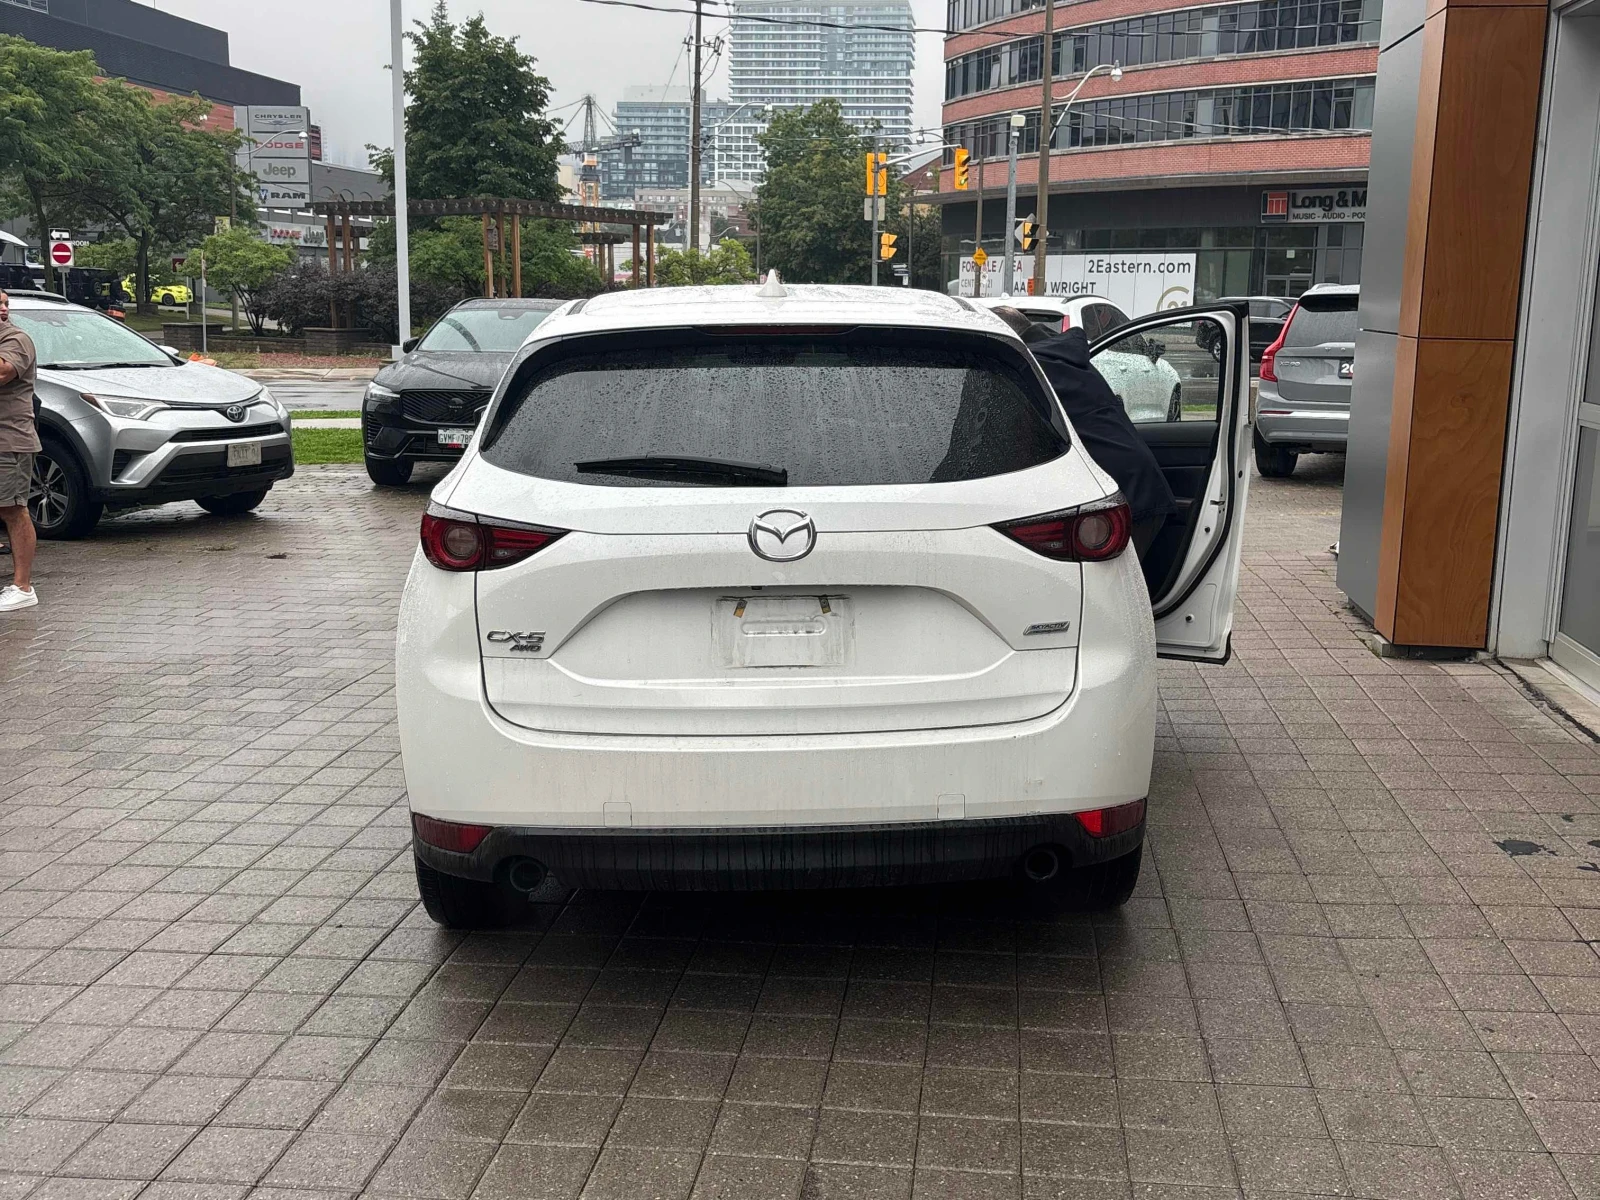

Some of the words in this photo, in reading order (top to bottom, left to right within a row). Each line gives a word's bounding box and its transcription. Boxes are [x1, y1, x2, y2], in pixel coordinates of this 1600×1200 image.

[255, 141, 304, 149] DODGE
[262, 162, 297, 178] Jeep
[1291, 192, 1334, 212] Long
[1335, 190, 1349, 208] &
[1322, 212, 1346, 220] AUDIO
[1088, 259, 1191, 274] 2Eastern.com
[1050, 281, 1097, 294] WRIGHT
[487, 630, 546, 643] CX-5
[509, 644, 542, 652] AWD
